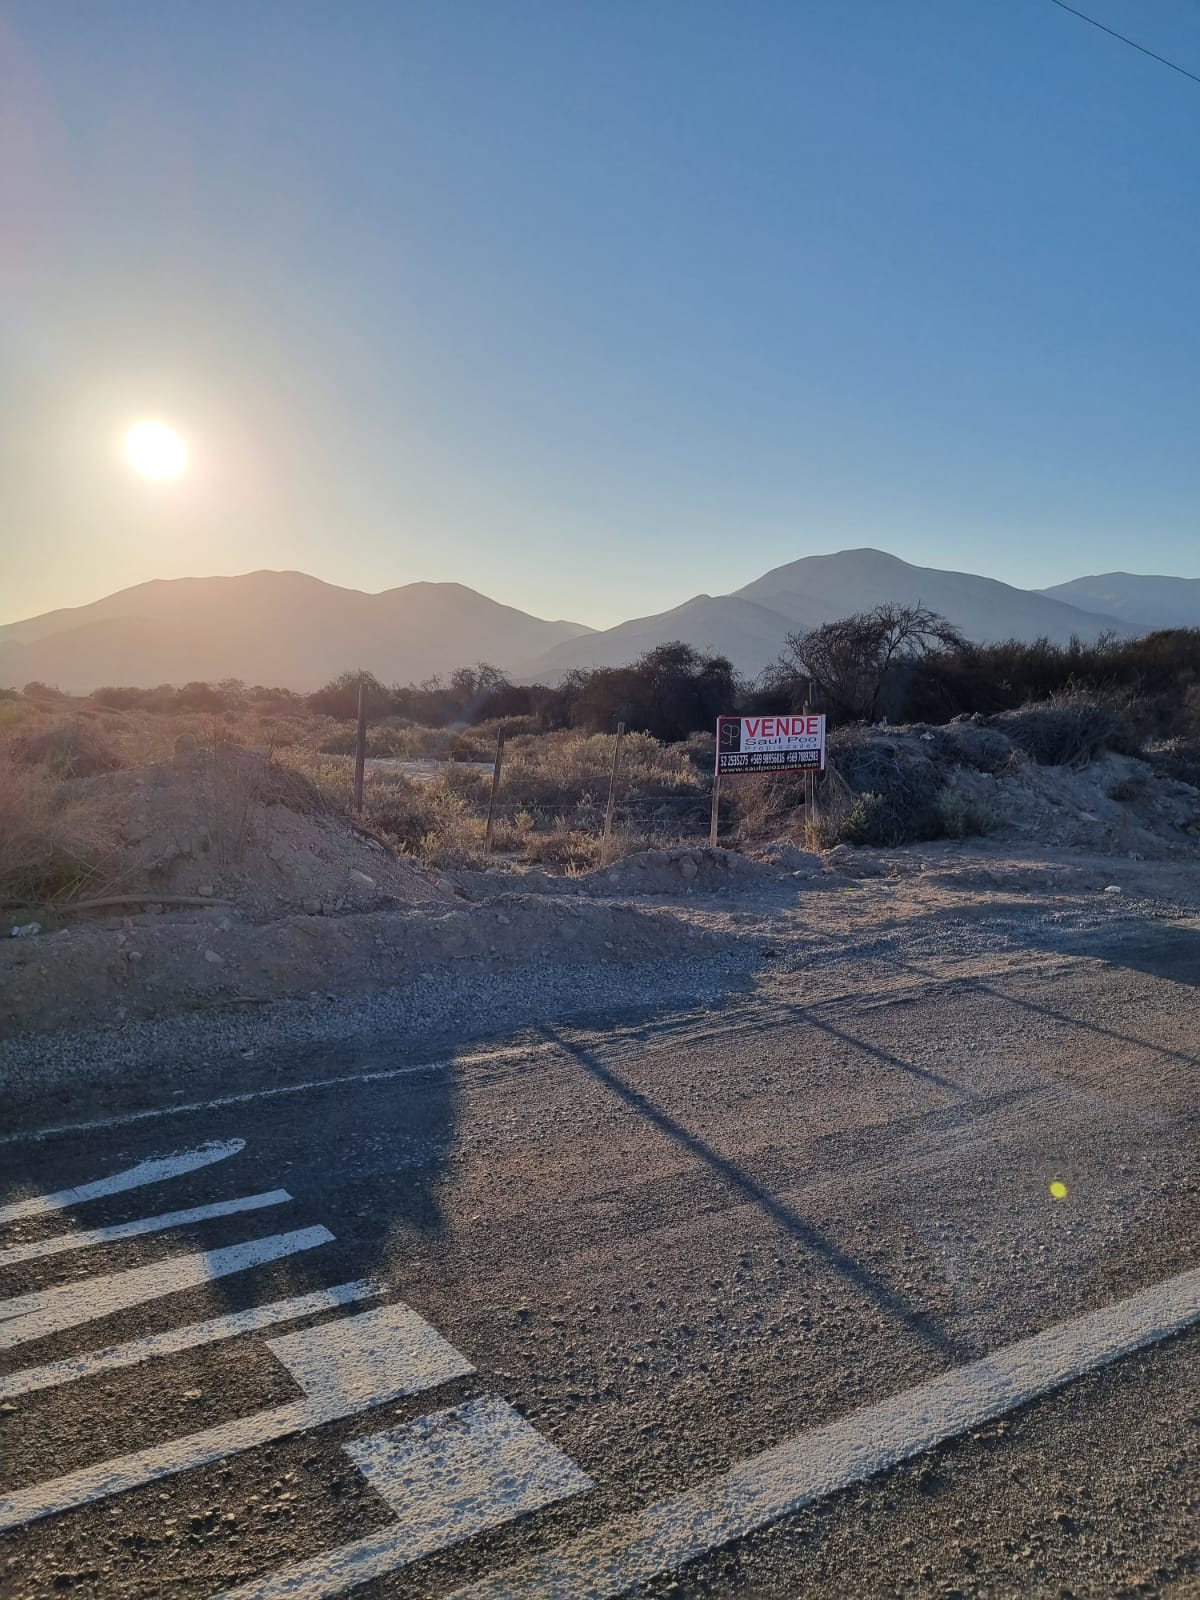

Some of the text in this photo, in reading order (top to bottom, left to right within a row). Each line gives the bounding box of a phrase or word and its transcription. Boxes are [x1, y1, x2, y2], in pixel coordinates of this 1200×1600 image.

[744, 718, 818, 737] VENDE
[745, 737, 781, 746] Saul
[720, 755, 727, 767] 52
[727, 754, 749, 766] 2535275
[750, 753, 762, 765] +569
[786, 752, 798, 763] +569
[720, 762, 819, 773] www.saulpoozapata.com
